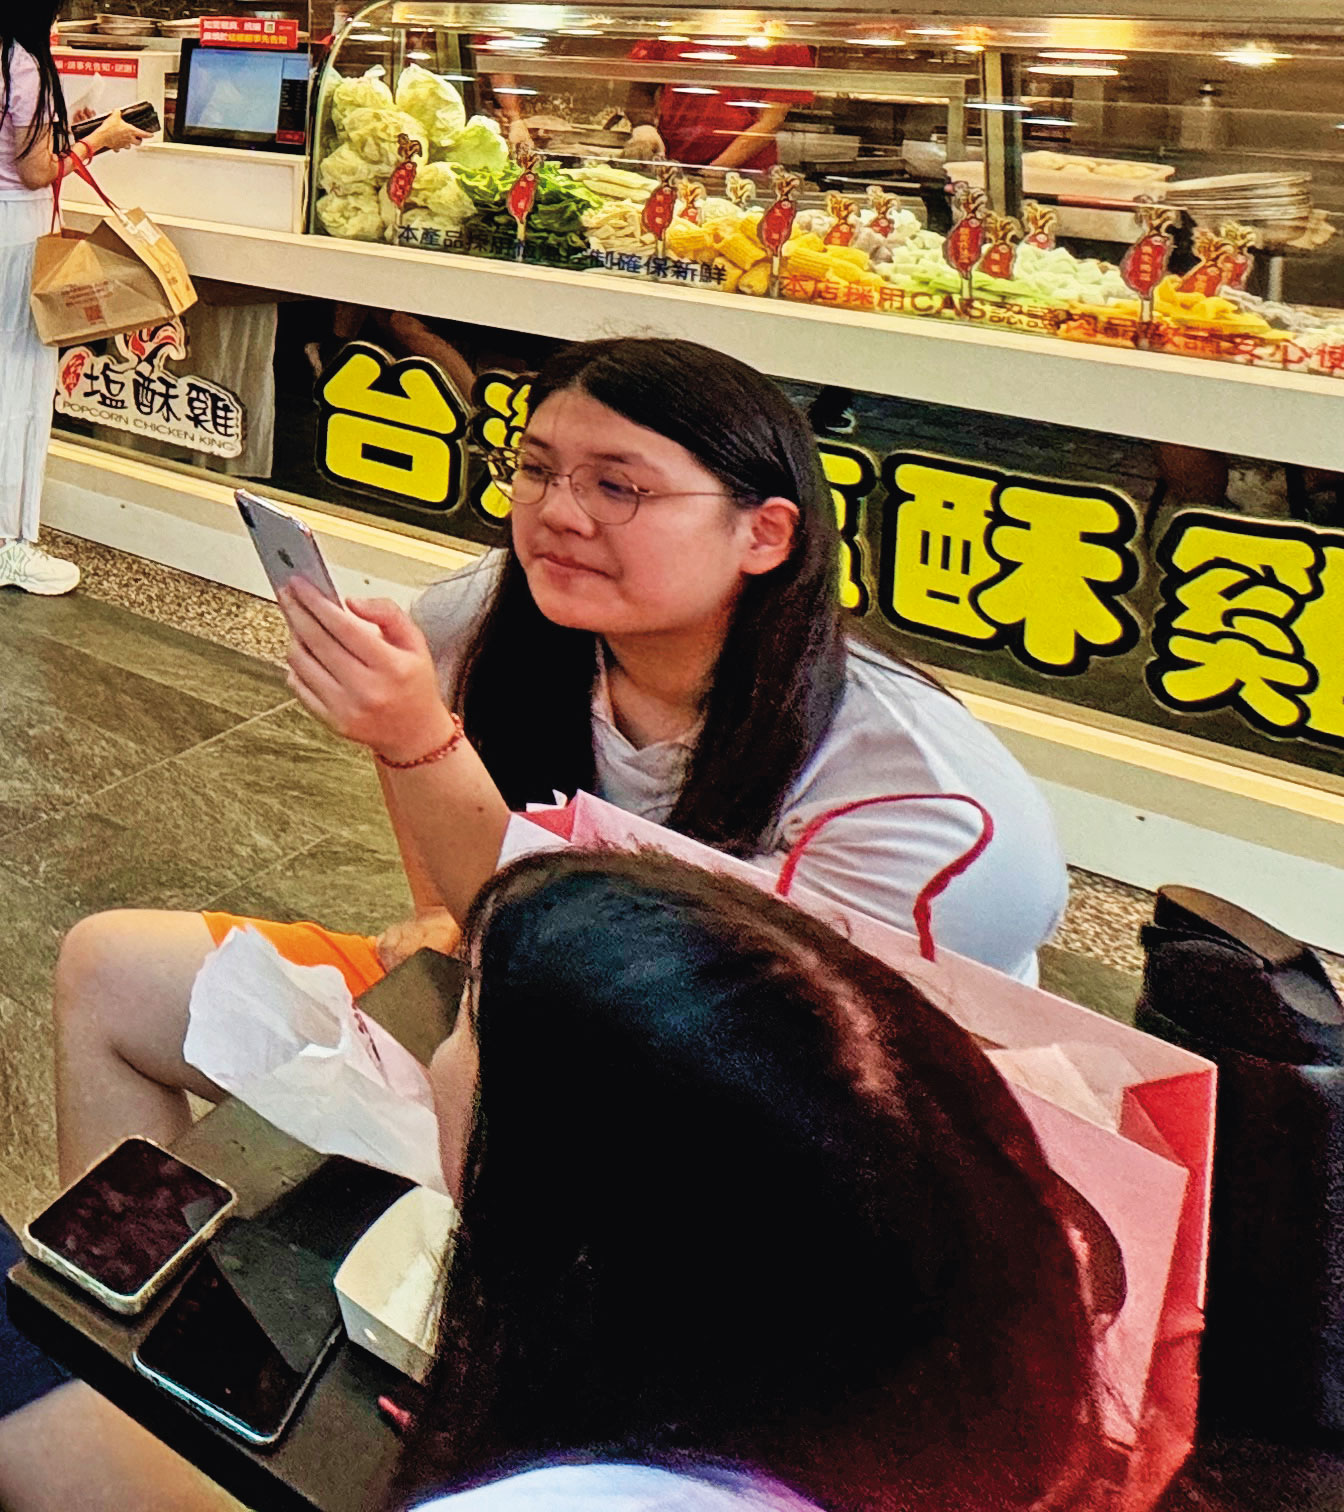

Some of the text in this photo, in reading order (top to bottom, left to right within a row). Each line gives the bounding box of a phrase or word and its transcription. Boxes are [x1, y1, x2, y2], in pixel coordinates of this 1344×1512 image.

[63, 400, 236, 451] POPCORN CHICKEN KING
